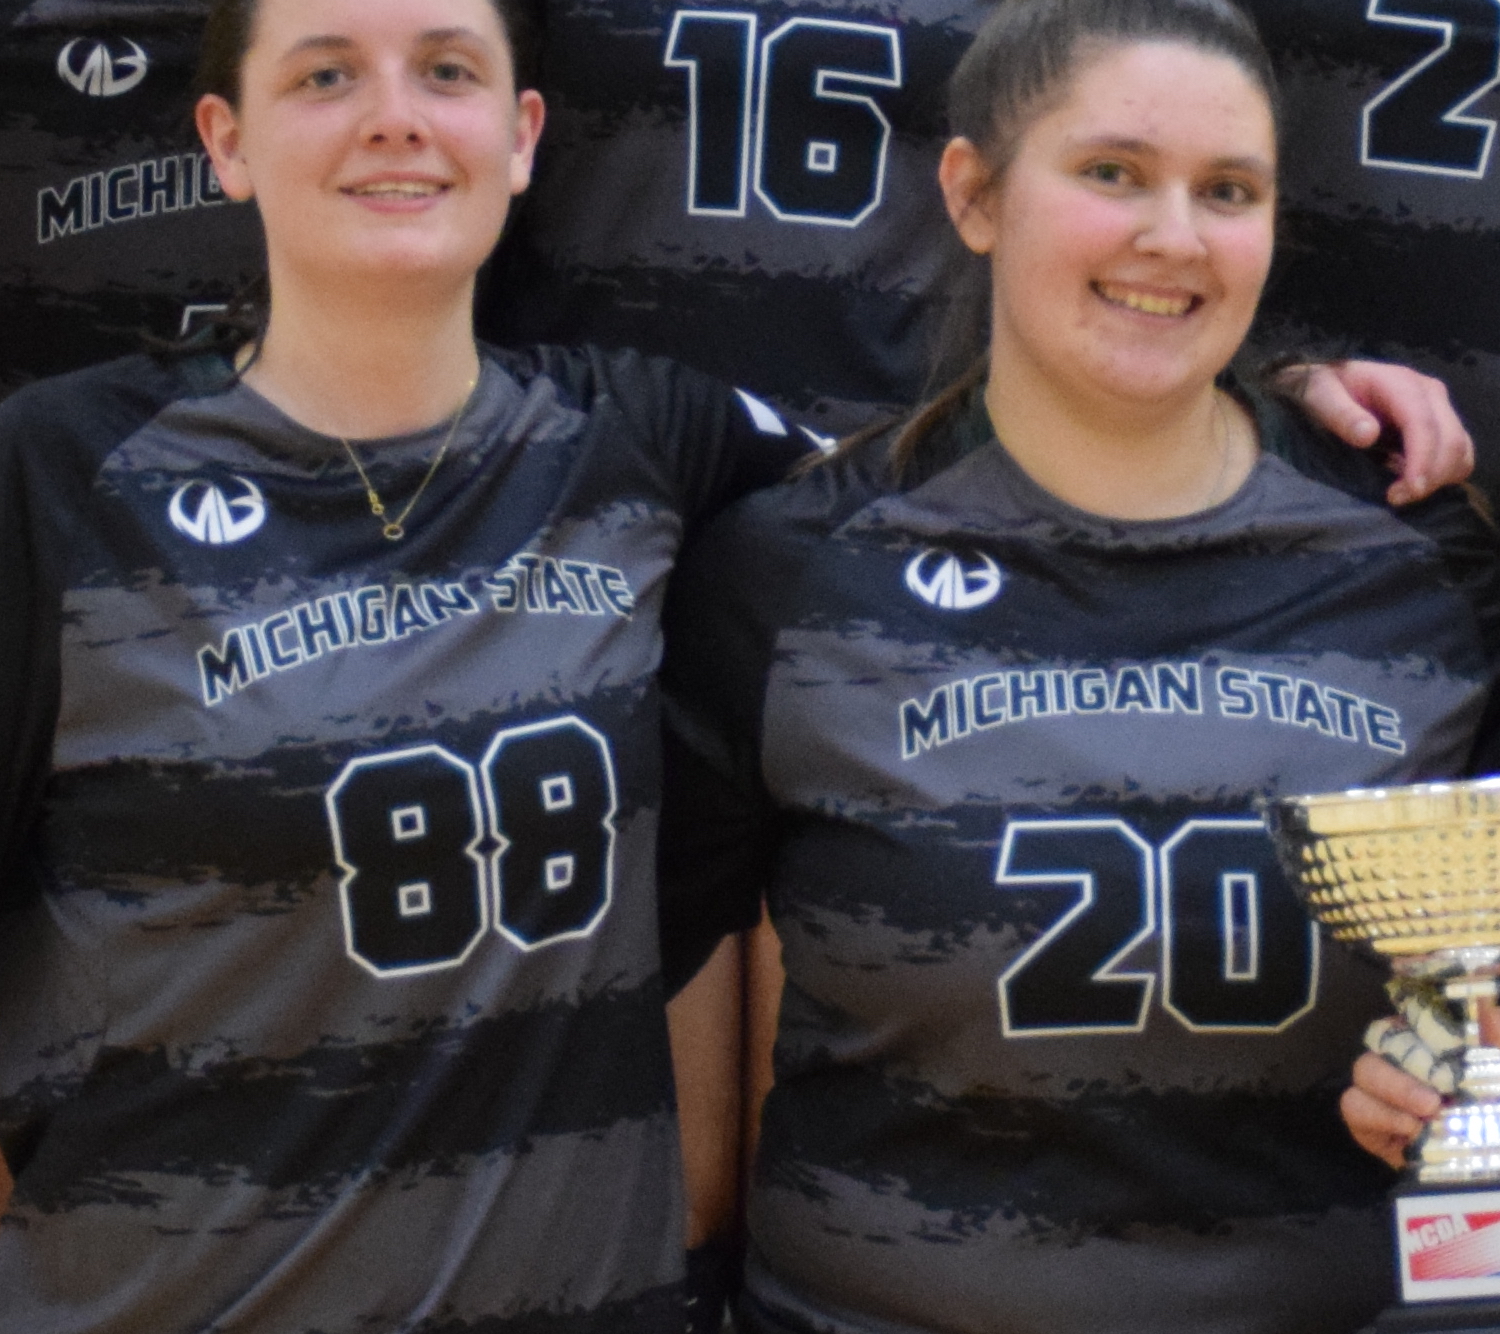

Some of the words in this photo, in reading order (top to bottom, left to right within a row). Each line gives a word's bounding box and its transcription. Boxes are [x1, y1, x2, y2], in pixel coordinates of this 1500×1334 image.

[37, 153, 227, 245] MICHIG
[664, 9, 902, 227] 16
[197, 585, 478, 706] MICHIGAN
[482, 552, 634, 621] STATE
[901, 663, 1202, 759] MICHIGAN
[1216, 666, 1405, 755] STATE
[325, 715, 617, 979] 88
[997, 820, 1320, 1037] 20
